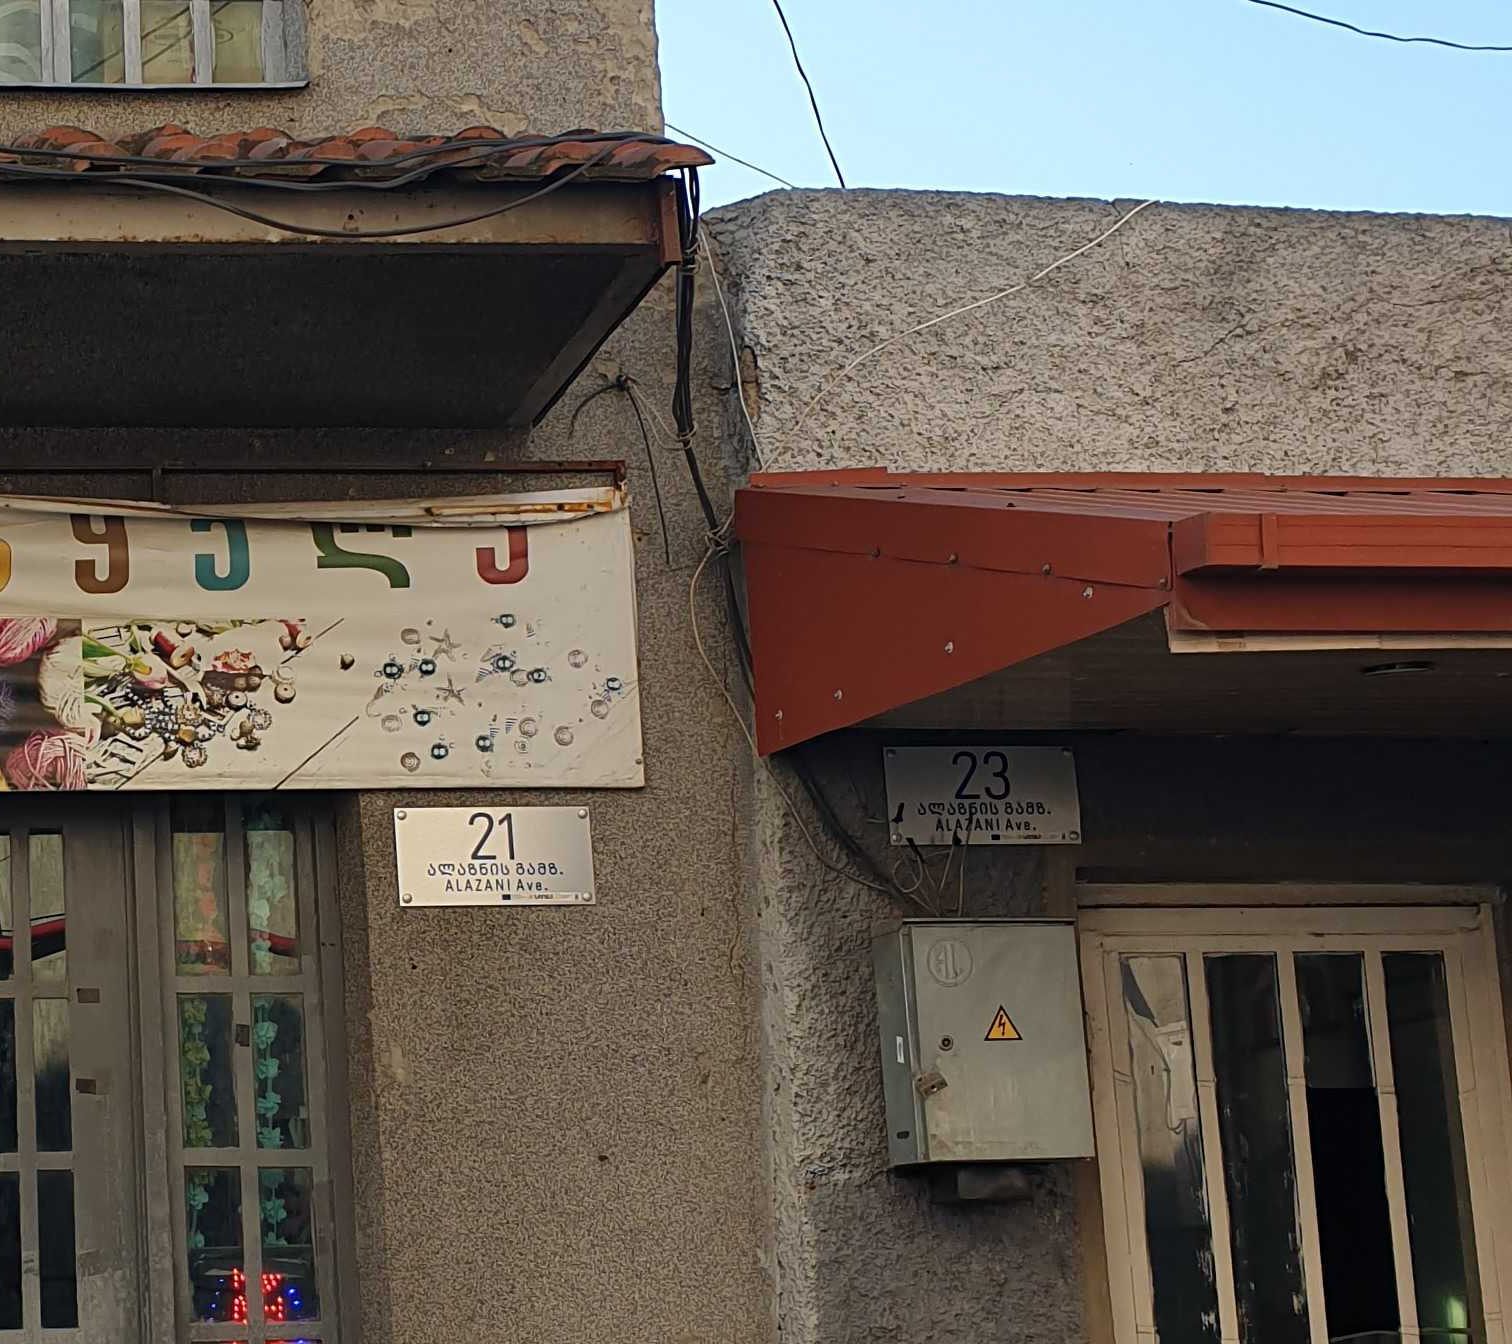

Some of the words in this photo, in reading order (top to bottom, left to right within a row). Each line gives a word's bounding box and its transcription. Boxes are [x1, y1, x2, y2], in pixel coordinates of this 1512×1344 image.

[951, 751, 1011, 800] 23
[917, 801, 999, 816] ალაზნის
[1004, 801, 1052, 816] გამზ.
[935, 817, 1000, 832] ALAZANI
[1005, 817, 1037, 831] Ave.
[468, 812, 515, 860] 21
[427, 862, 510, 876] ალაზნის
[515, 862, 564, 876] გამზ.
[445, 878, 511, 892] ALAZANI
[516, 878, 549, 892] Ave.
